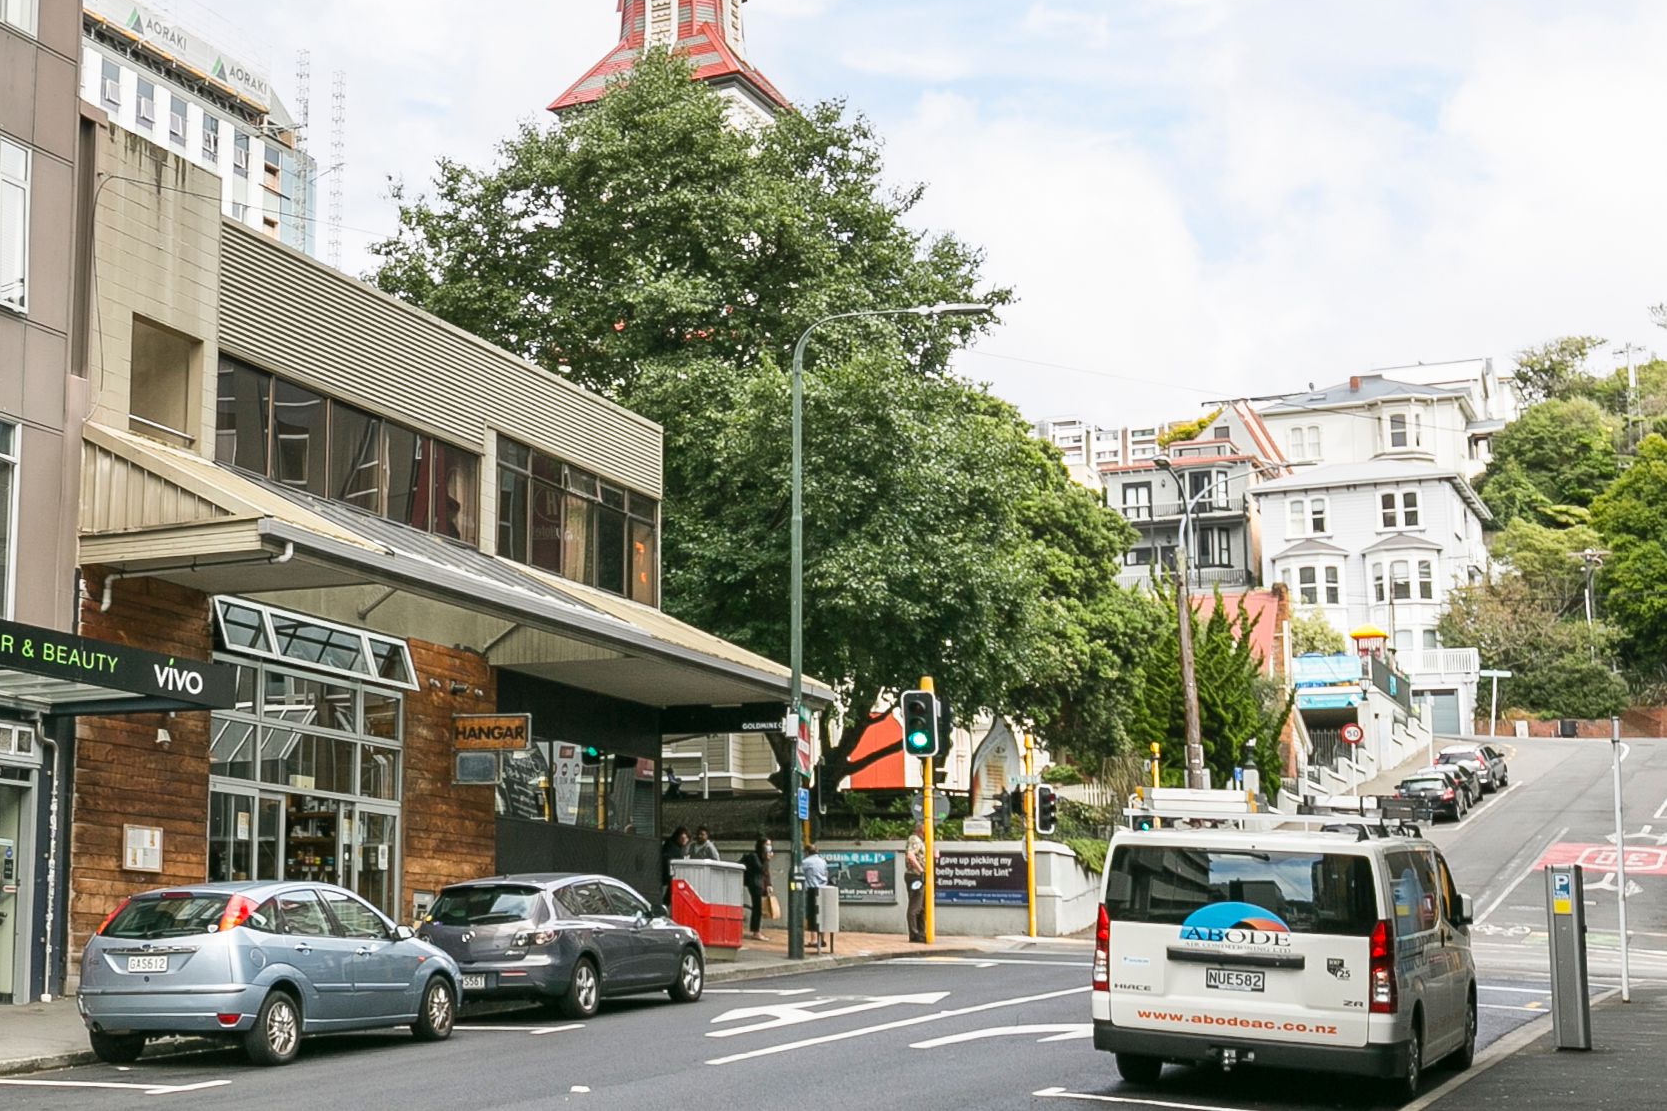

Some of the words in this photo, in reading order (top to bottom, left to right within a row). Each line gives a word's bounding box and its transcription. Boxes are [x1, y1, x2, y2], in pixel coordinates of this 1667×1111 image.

[145, 18, 187, 51] AORAKI
[228, 65, 268, 95] AORAKI
[22, 639, 35, 658] &
[42, 642, 119, 674] BEAUTY
[154, 658, 204, 695] VIVO
[454, 725, 525, 740] HANGAR
[1346, 730, 1359, 738] 50
[940, 857, 958, 865] gave
[959, 857, 969, 865] up
[970, 856, 999, 866] picking
[1000, 857, 1012, 866] my
[935, 867, 954, 877] belly
[955, 868, 980, 876] button
[981, 868, 993, 876] for
[1554, 875, 1569, 890] P
[1185, 926, 1292, 947] ABODE
[463, 974, 484, 989] S561
[1208, 970, 1262, 988] NUE582
[1114, 983, 1152, 992] HIACE
[1137, 1009, 1338, 1035] www.abodeac.co.nz
